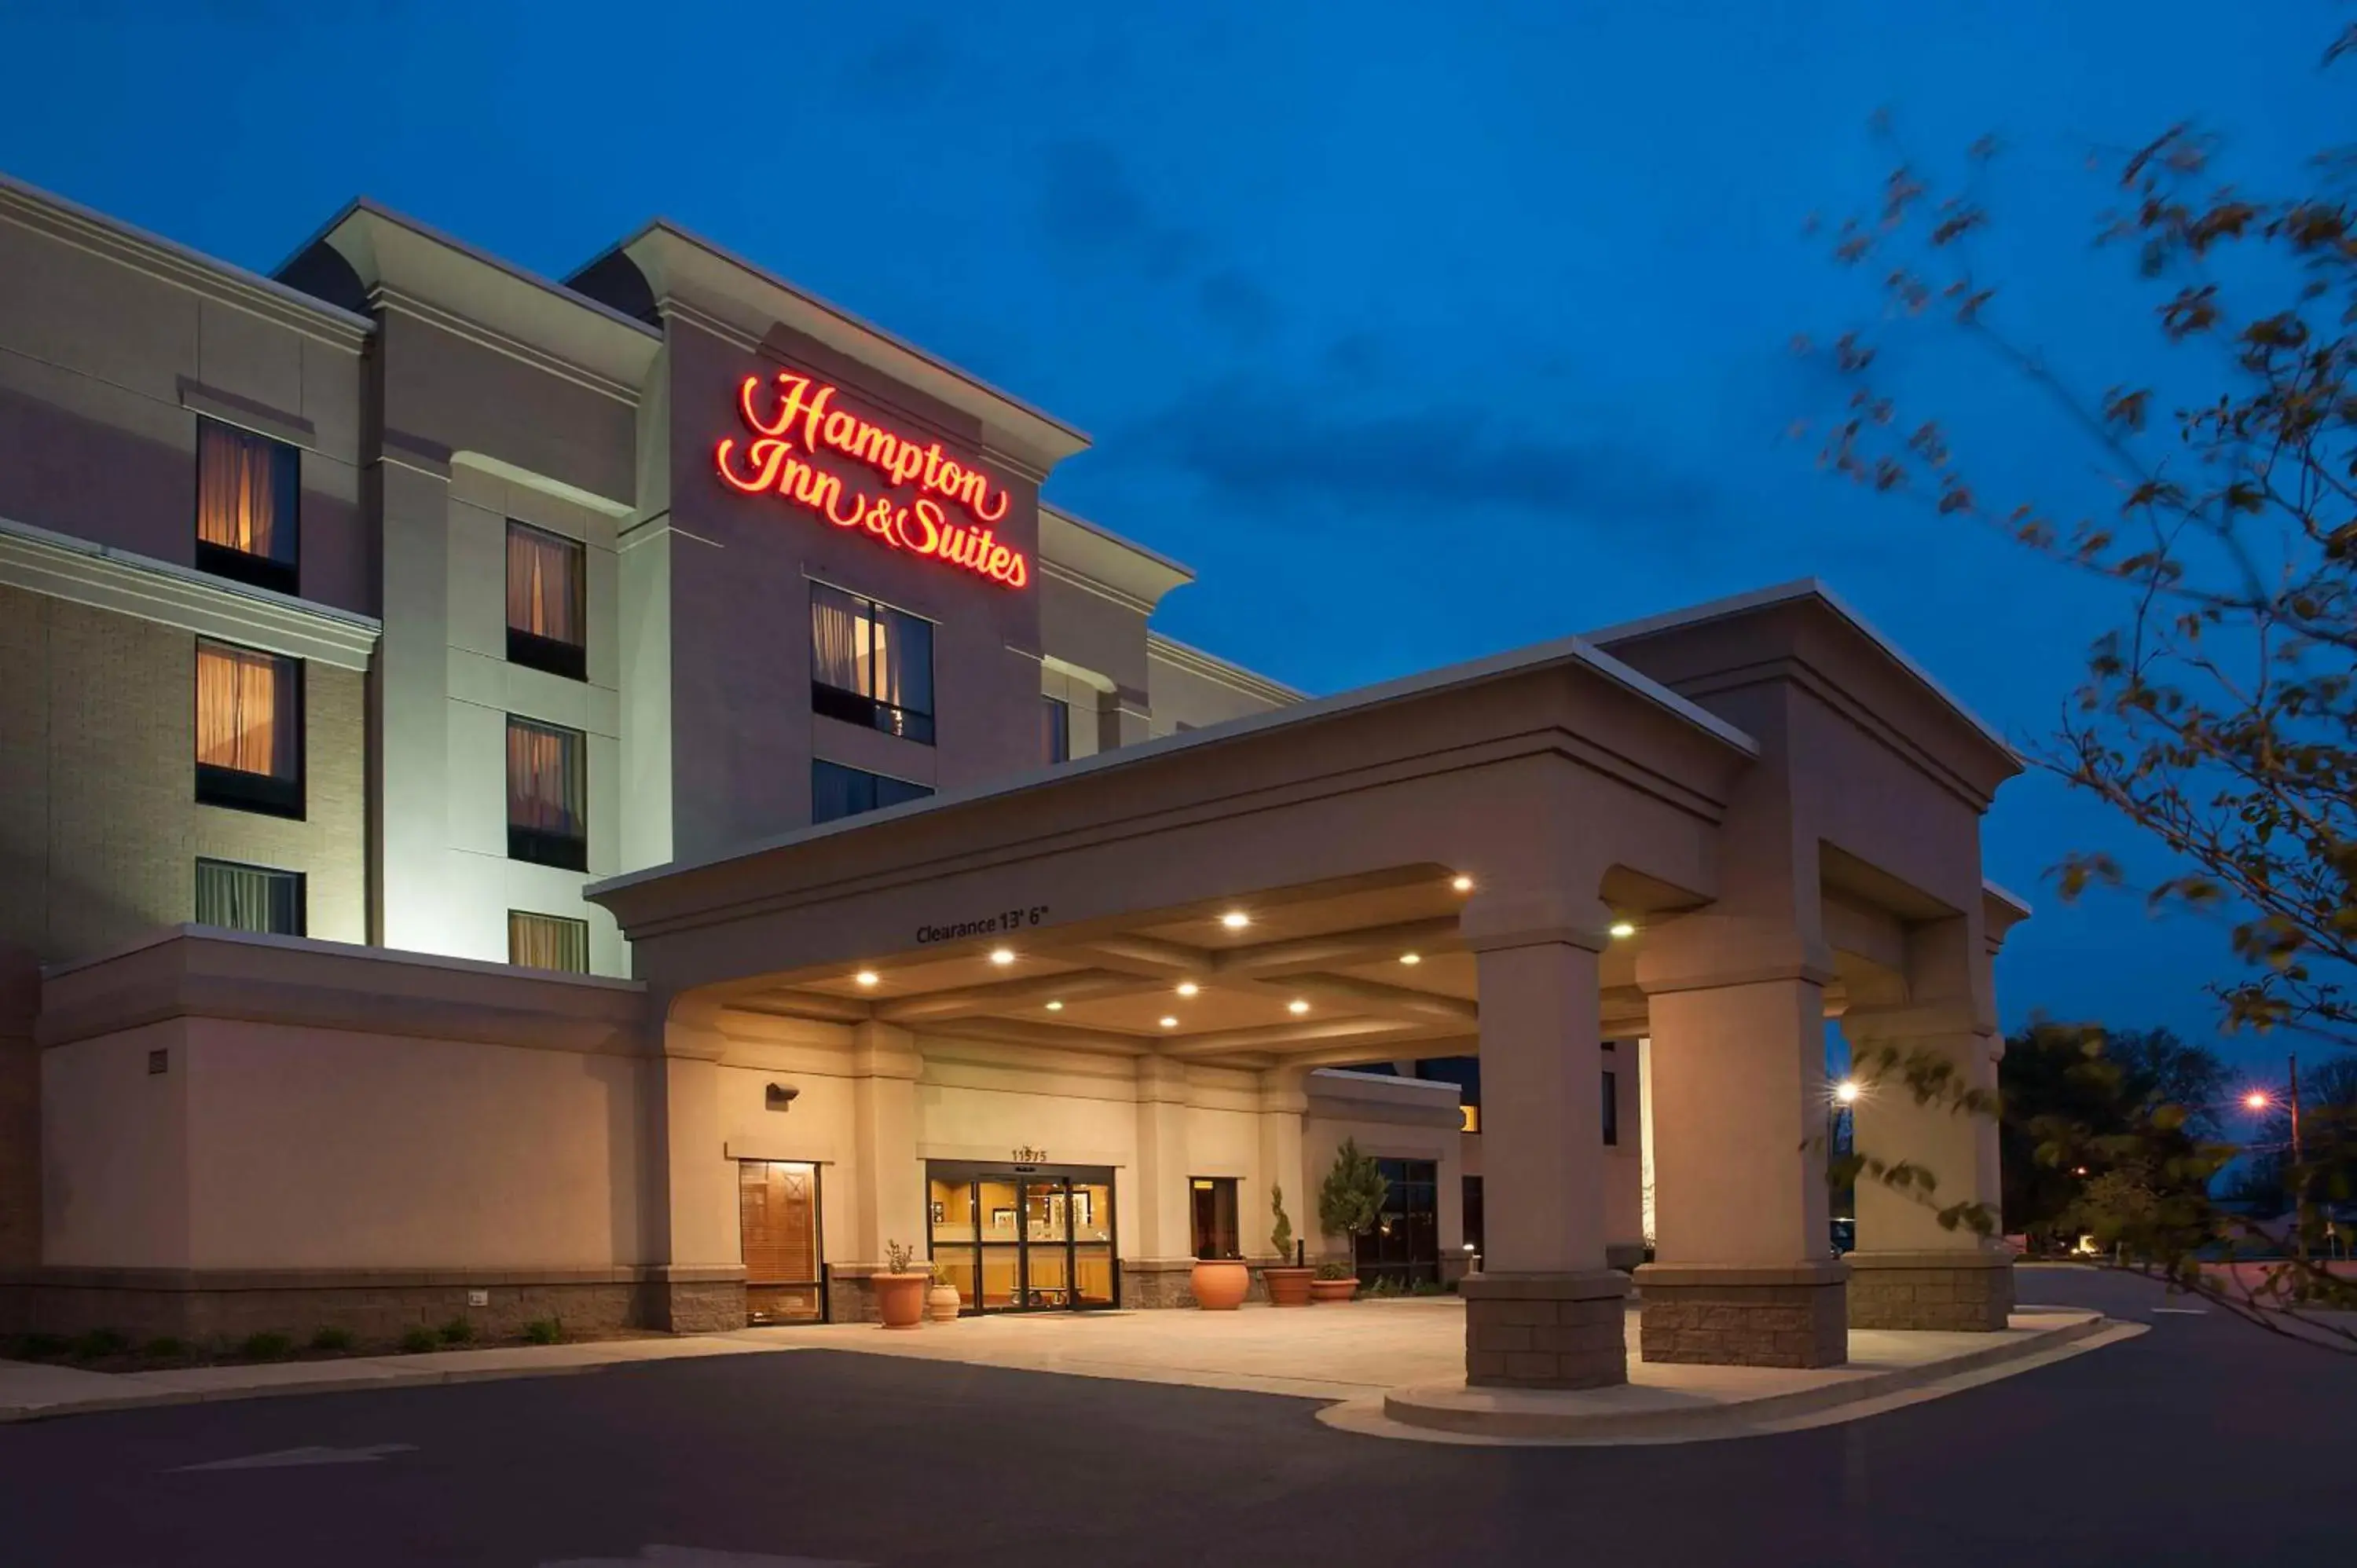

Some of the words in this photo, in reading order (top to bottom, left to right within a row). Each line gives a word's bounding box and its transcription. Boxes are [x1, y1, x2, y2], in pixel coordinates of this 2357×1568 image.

[717, 438, 864, 526] Inn
[866, 498, 901, 547] &
[896, 498, 1028, 588] Suites
[742, 372, 1008, 522] Hampton
[916, 918, 996, 943] Clearance
